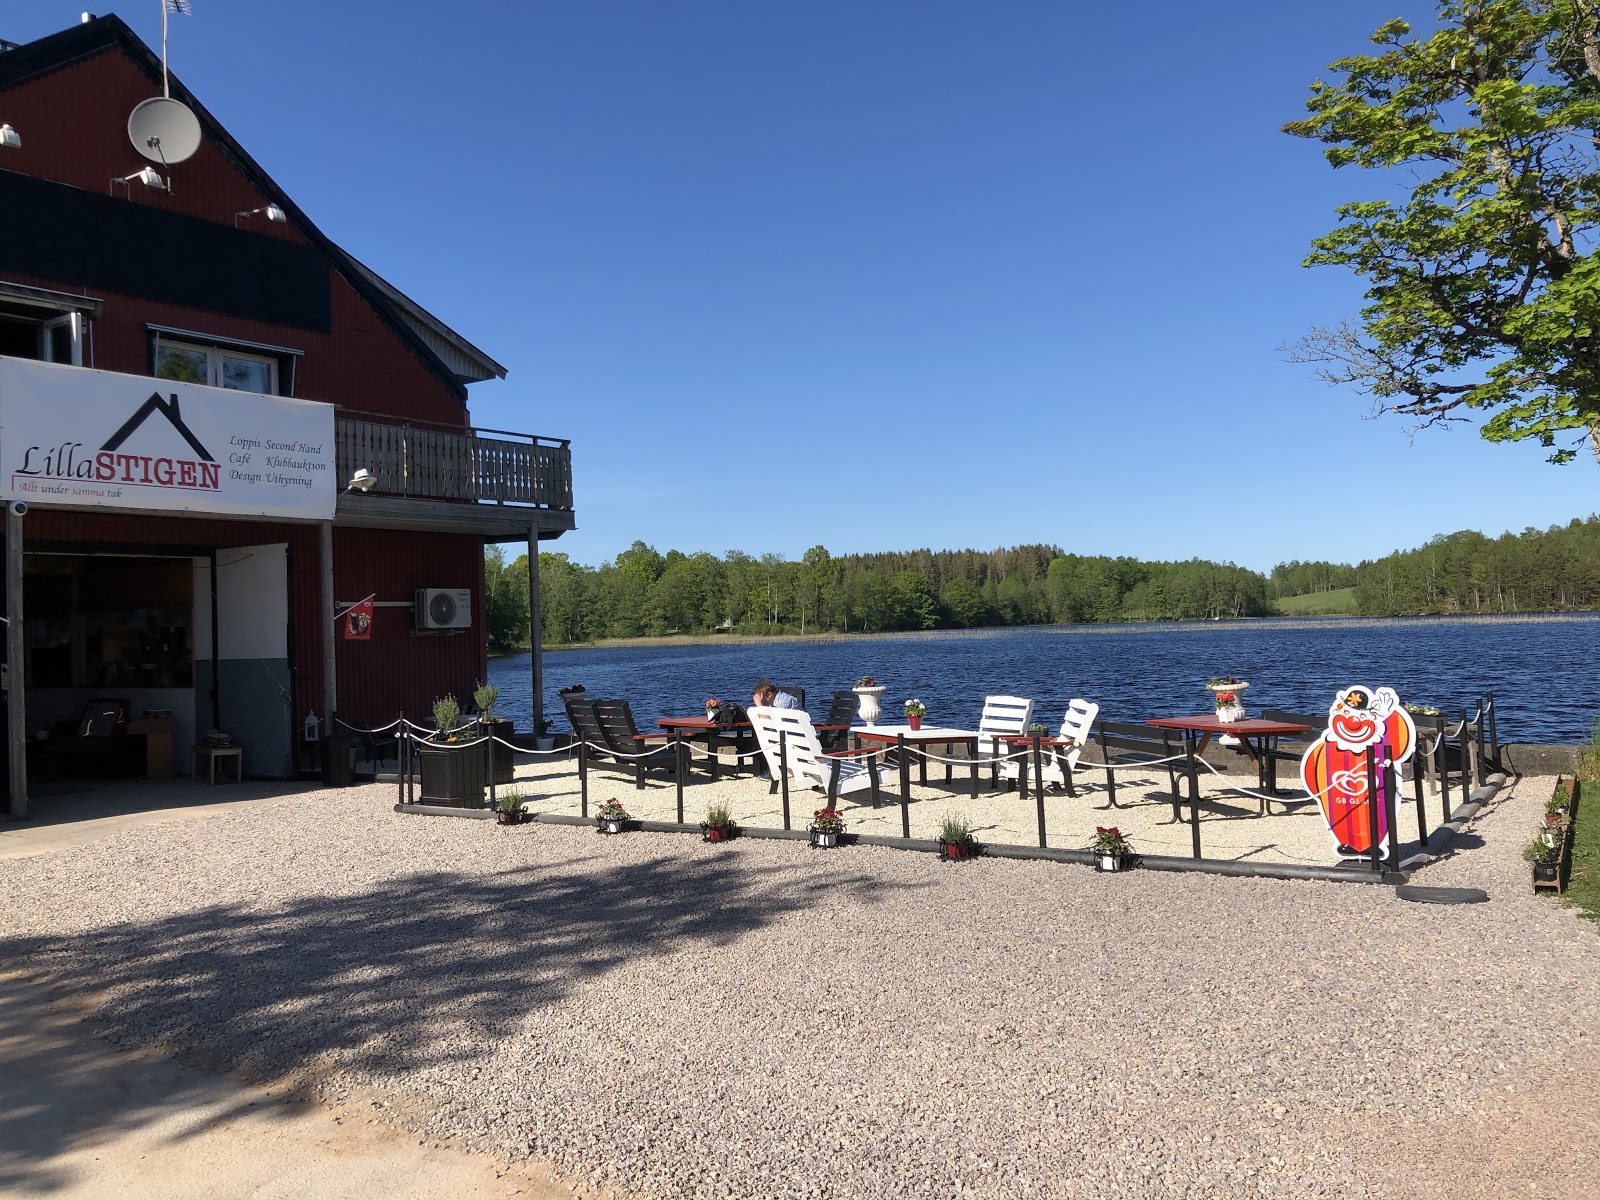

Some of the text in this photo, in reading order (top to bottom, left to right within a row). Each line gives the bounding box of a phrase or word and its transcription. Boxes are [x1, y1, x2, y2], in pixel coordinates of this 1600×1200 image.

[229, 435, 323, 454] Loppis Second Hand
[229, 452, 252, 467] Café
[265, 455, 326, 472] Klubbauktion
[228, 469, 262, 485] Design
[265, 472, 313, 489] Uthyrning
[18, 481, 122, 498] Allt under samma tak
